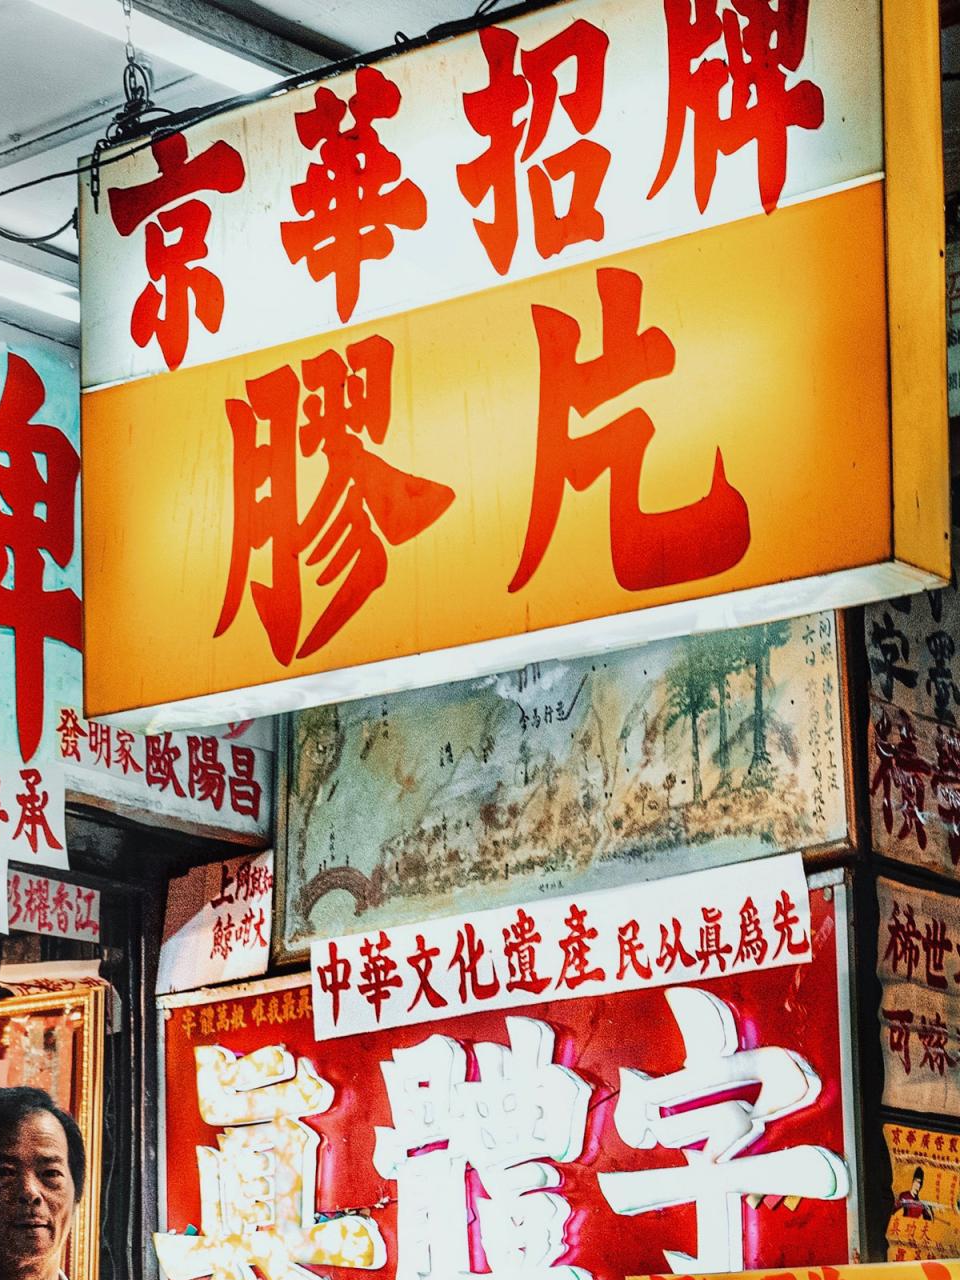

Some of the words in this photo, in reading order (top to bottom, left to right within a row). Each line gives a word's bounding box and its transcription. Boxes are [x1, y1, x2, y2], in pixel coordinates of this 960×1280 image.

[107, 0, 824, 372] 京華招牌
[213, 267, 752, 668] 膠片
